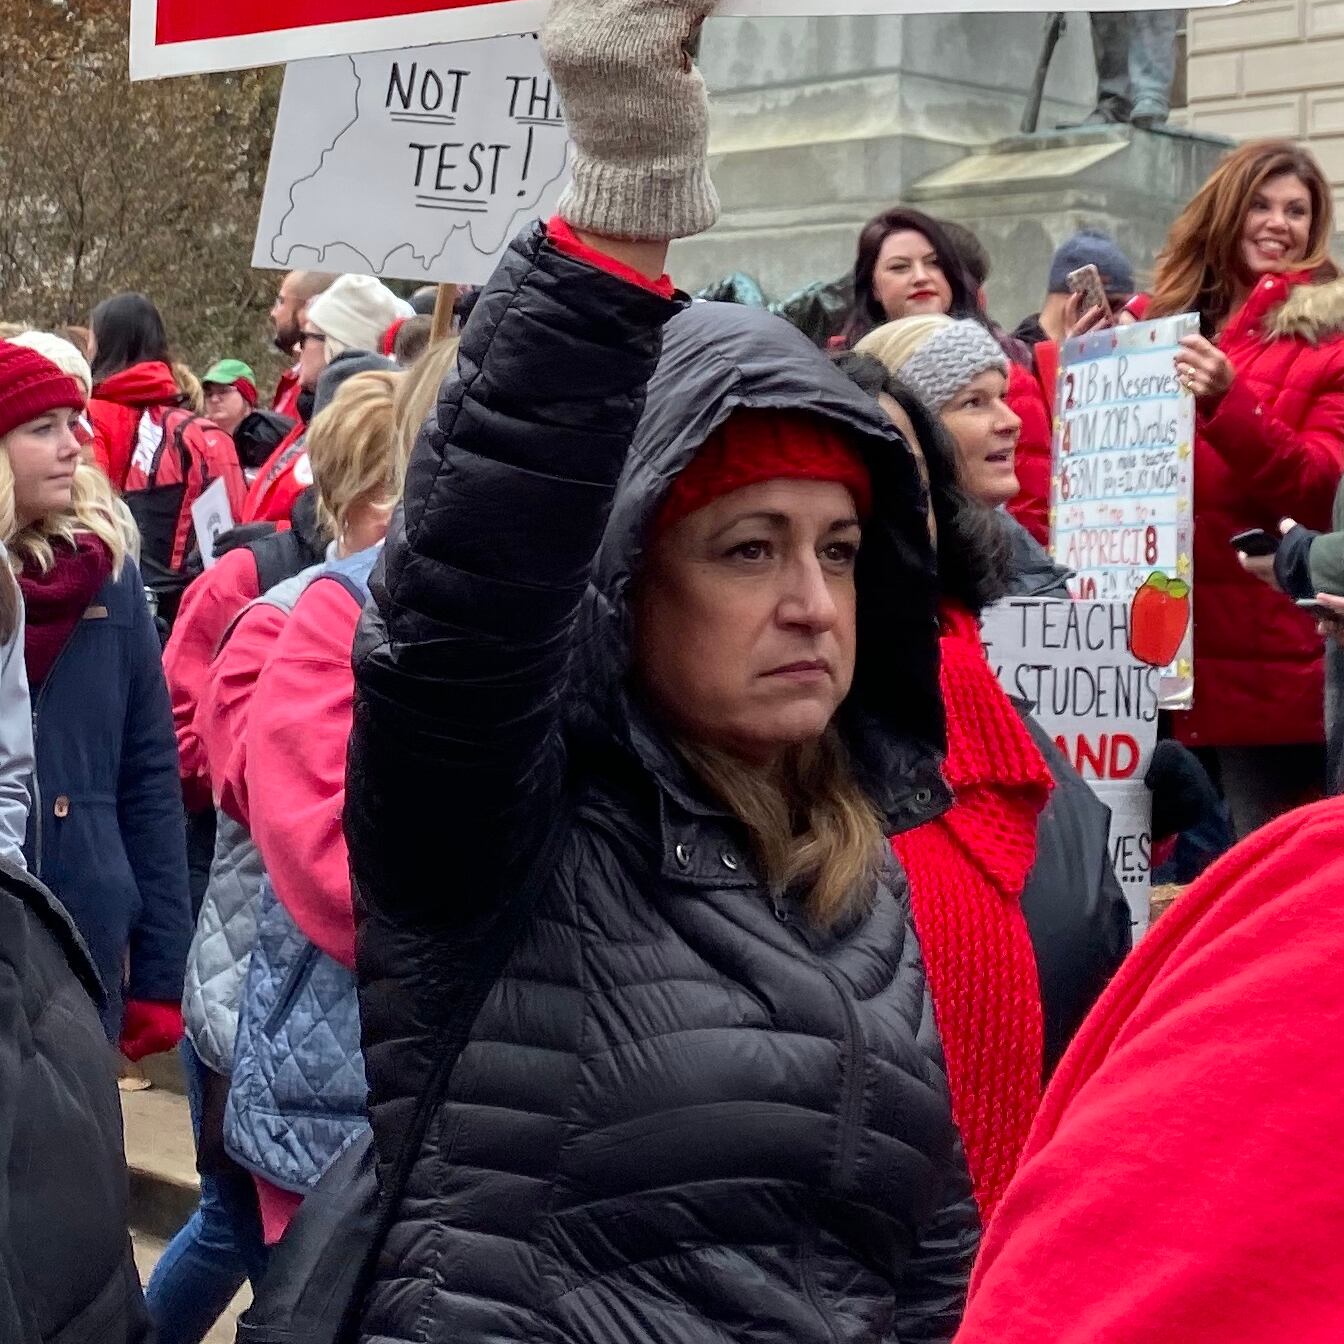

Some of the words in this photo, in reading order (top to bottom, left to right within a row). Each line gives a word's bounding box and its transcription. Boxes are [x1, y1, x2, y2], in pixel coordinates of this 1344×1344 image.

[386, 62, 471, 113] NOT
[506, 76, 562, 120] TH
[409, 126, 534, 197] TEST!
[1116, 356, 1181, 399] Reserves
[1067, 524, 1159, 567] APPRECI8
[1010, 601, 1130, 651] TEACH
[1015, 664, 1159, 722] STUDENTS
